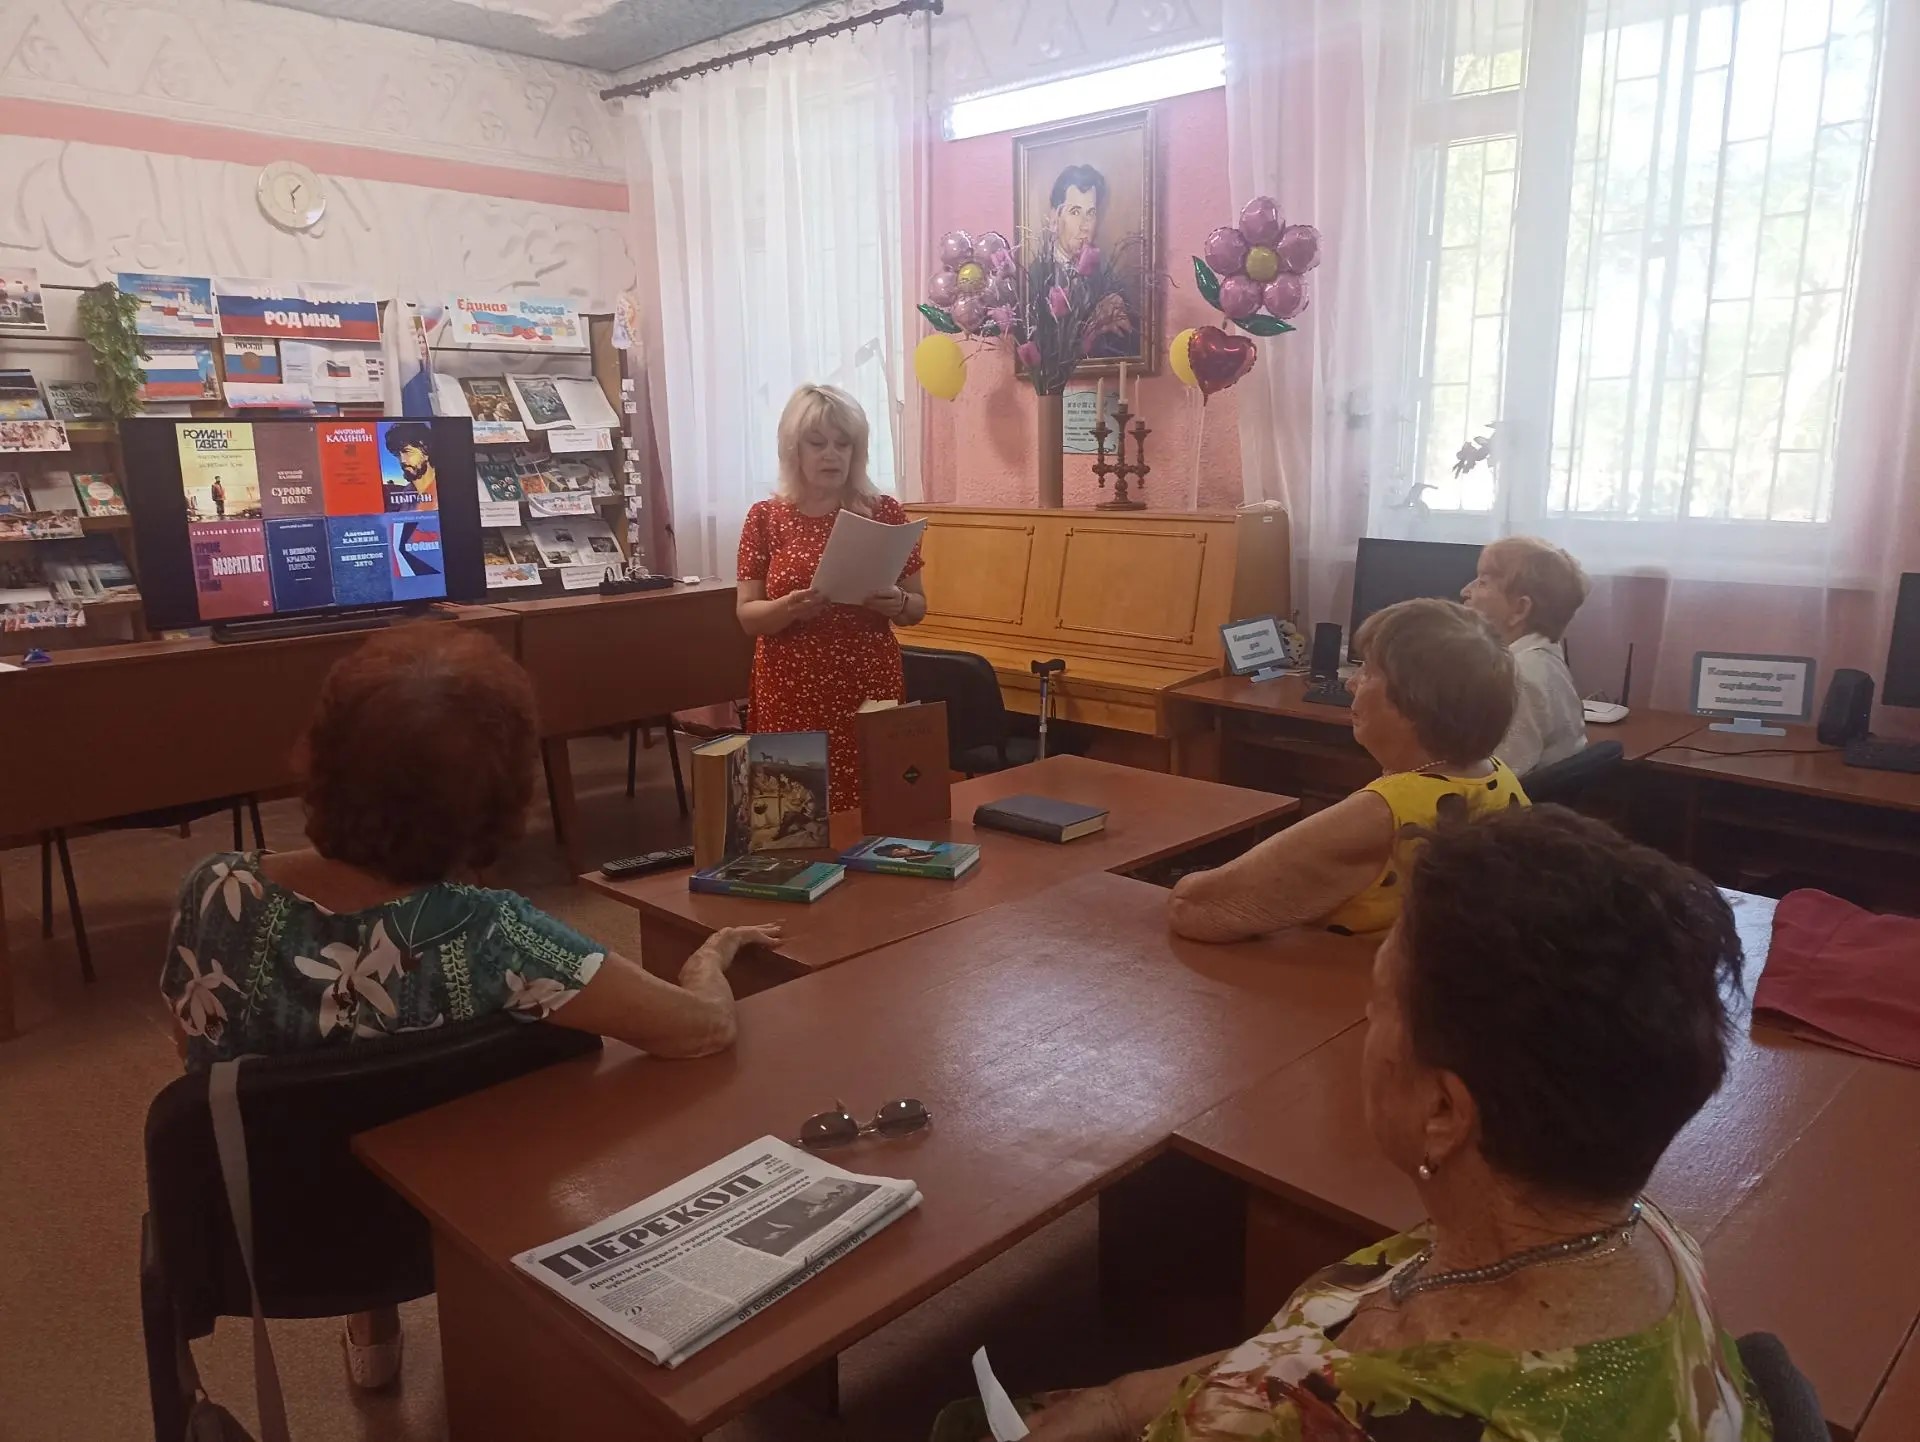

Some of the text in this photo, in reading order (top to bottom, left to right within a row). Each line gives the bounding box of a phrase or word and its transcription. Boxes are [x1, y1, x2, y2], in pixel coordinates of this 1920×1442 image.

[457, 298, 565, 316] Единая Россия
[264, 311, 342, 329] РОДИНЫ
[195, 439, 228, 449] ГАЗЕТА
[325, 434, 373, 443] КАЛИНИН
[271, 486, 313, 497] СУРОВОЕ
[281, 495, 306, 505] ПОЛЕ
[390, 493, 432, 504] ЦЫГАН
[342, 535, 380, 544] КАЛИНИН
[211, 554, 265, 576] ВОЗВРАТА НЕТ
[539, 1174, 764, 1280] ПЕРЕКОП
[589, 1266, 634, 1290] Депутаты
